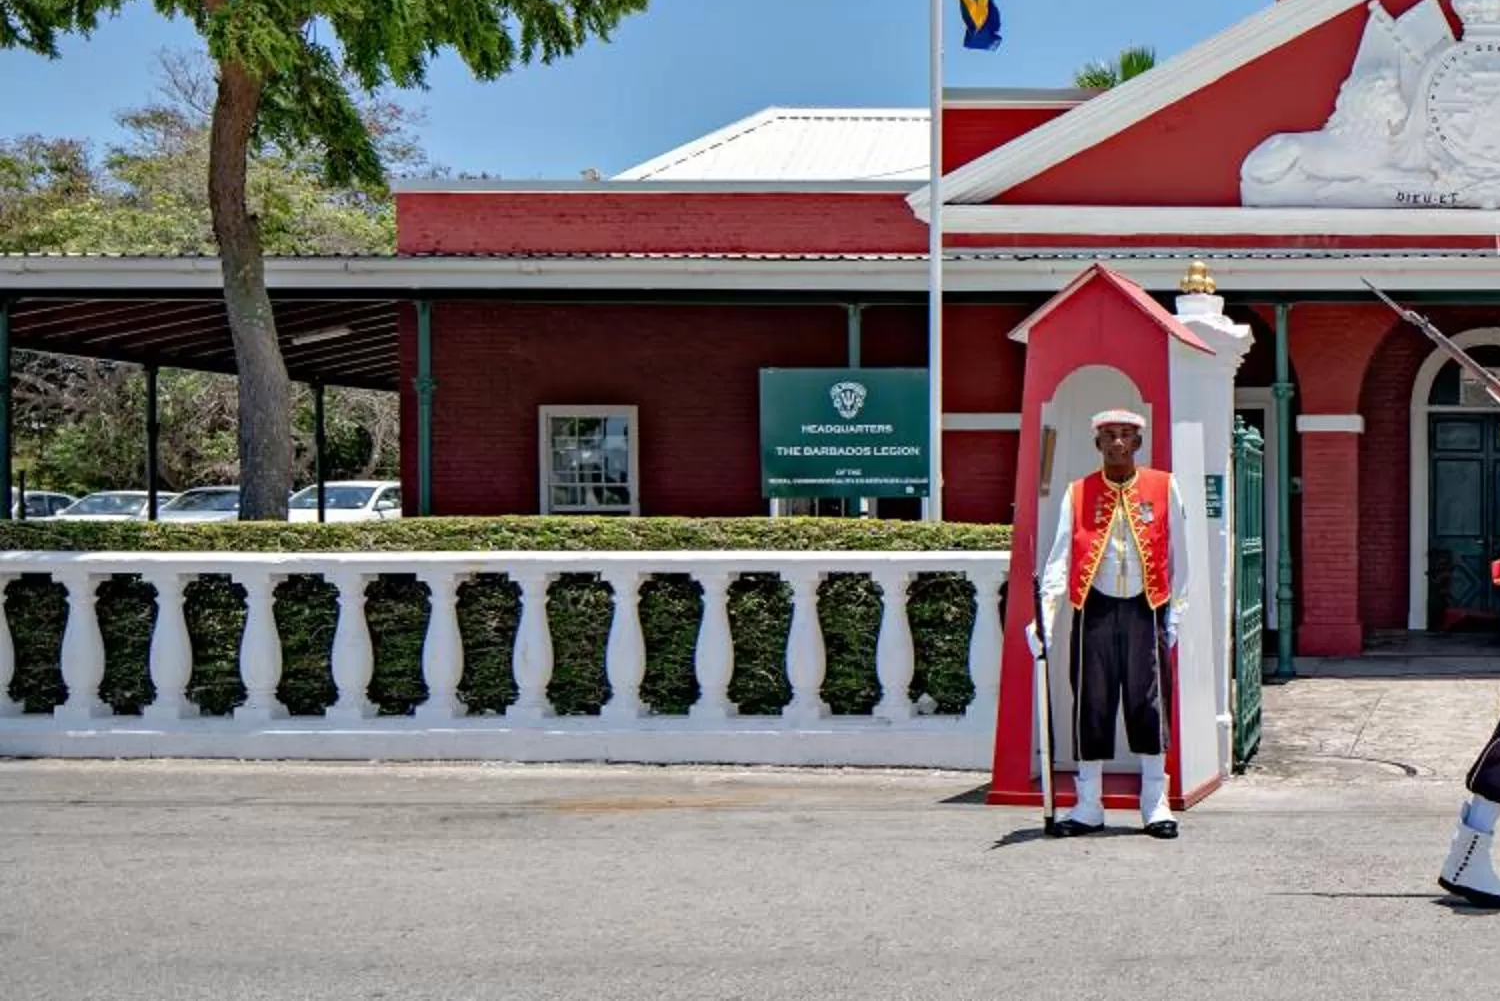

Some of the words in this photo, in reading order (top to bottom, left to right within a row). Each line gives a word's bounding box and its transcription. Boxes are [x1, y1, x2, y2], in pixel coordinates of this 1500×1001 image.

[802, 424, 894, 435] HEADQUARTERS
[776, 446, 802, 456] THE
[803, 446, 871, 456] BARBADOS
[873, 446, 921, 456] LEGION
